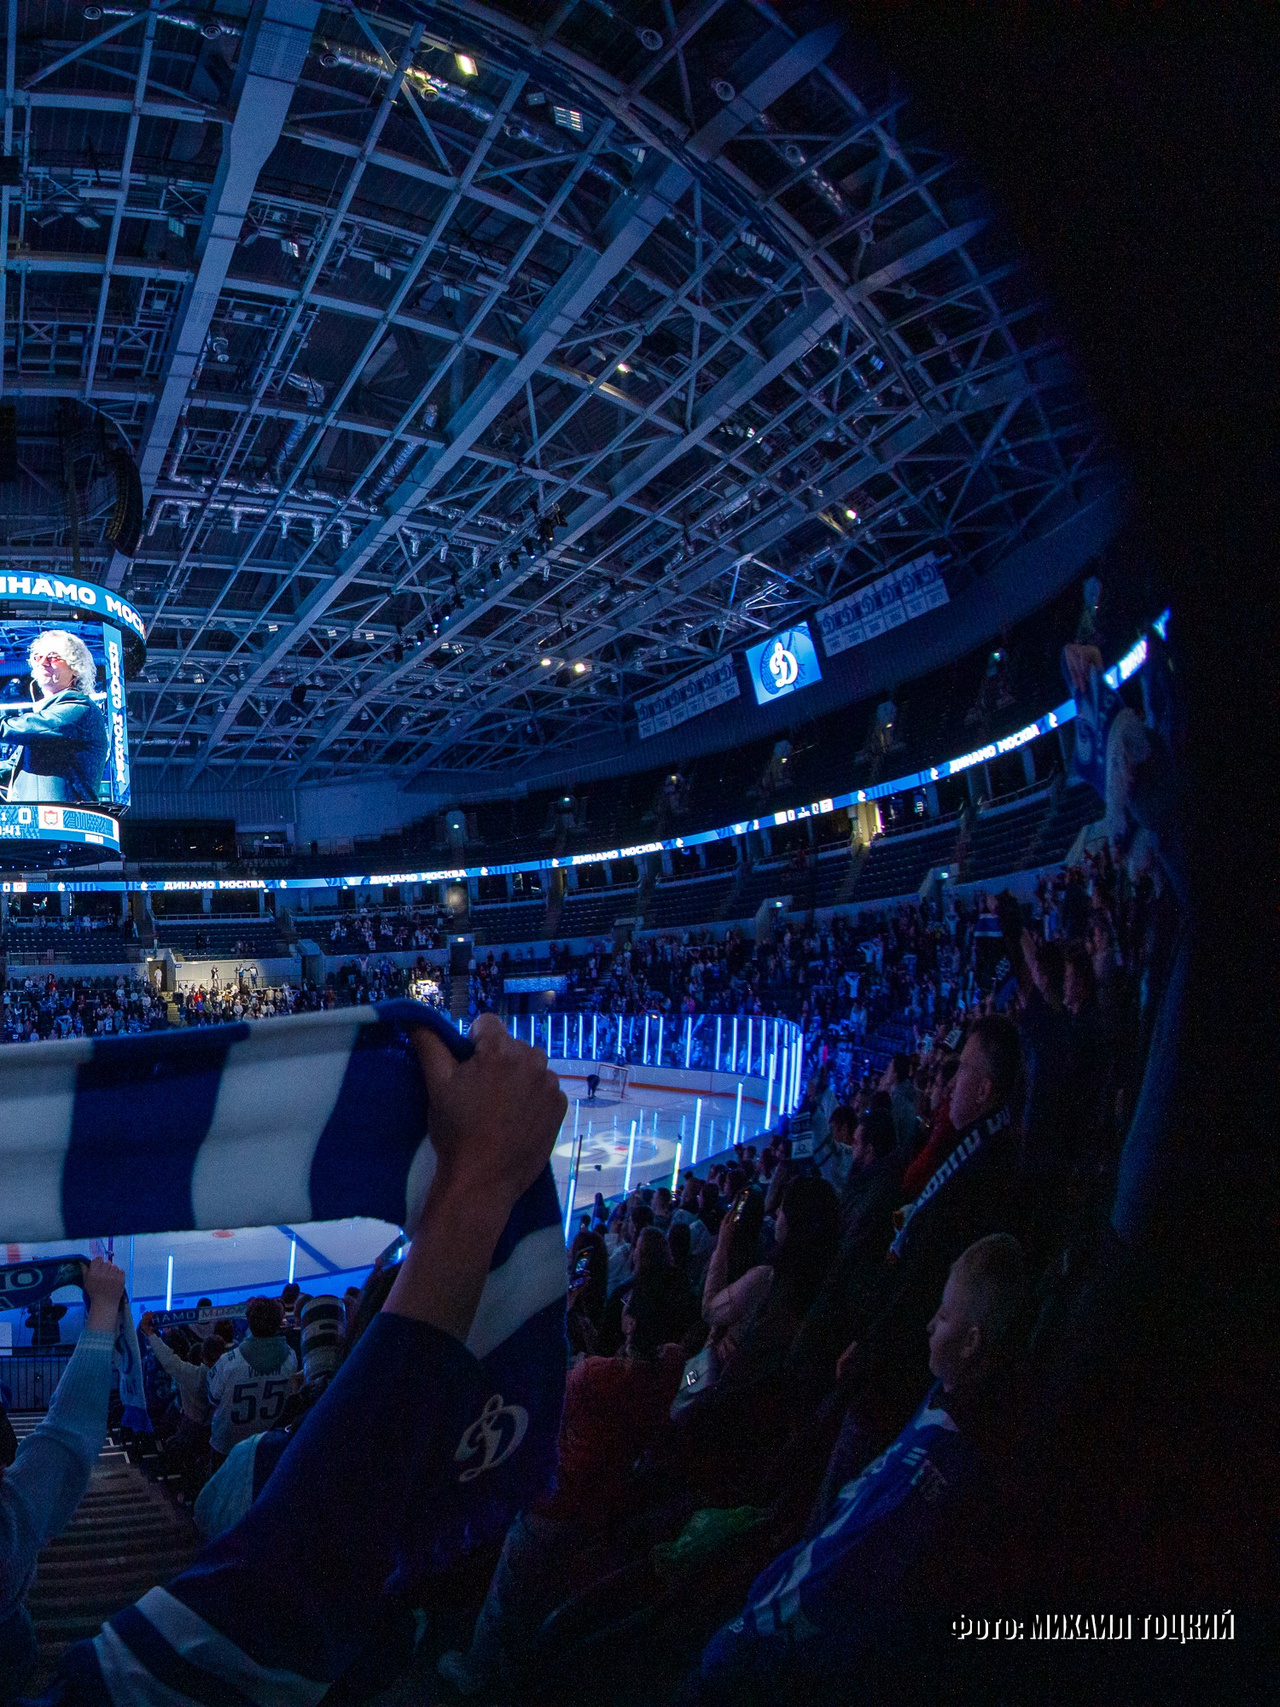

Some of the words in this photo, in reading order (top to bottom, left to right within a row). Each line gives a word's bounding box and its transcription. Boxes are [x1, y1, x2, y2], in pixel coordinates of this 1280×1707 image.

[108, 640, 122, 709] ДИНАМО
[111, 711, 126, 784] МОСКВА
[949, 745, 996, 774] ДИНАМО
[996, 723, 1040, 753] МОСКВА
[1, 812, 7, 822] 1
[17, 807, 32, 825] 0
[571, 851, 618, 866] ДИНАМО
[620, 842, 664, 858] МОСКВА
[163, 879, 216, 891] ДИНАМО
[219, 879, 267, 890] МОСКВА
[369, 872, 418, 884] ДИНАМО
[420, 868, 467, 882] МОСКВА
[151, 1310, 196, 1324] НАМО
[230, 1379, 290, 1426] 55
